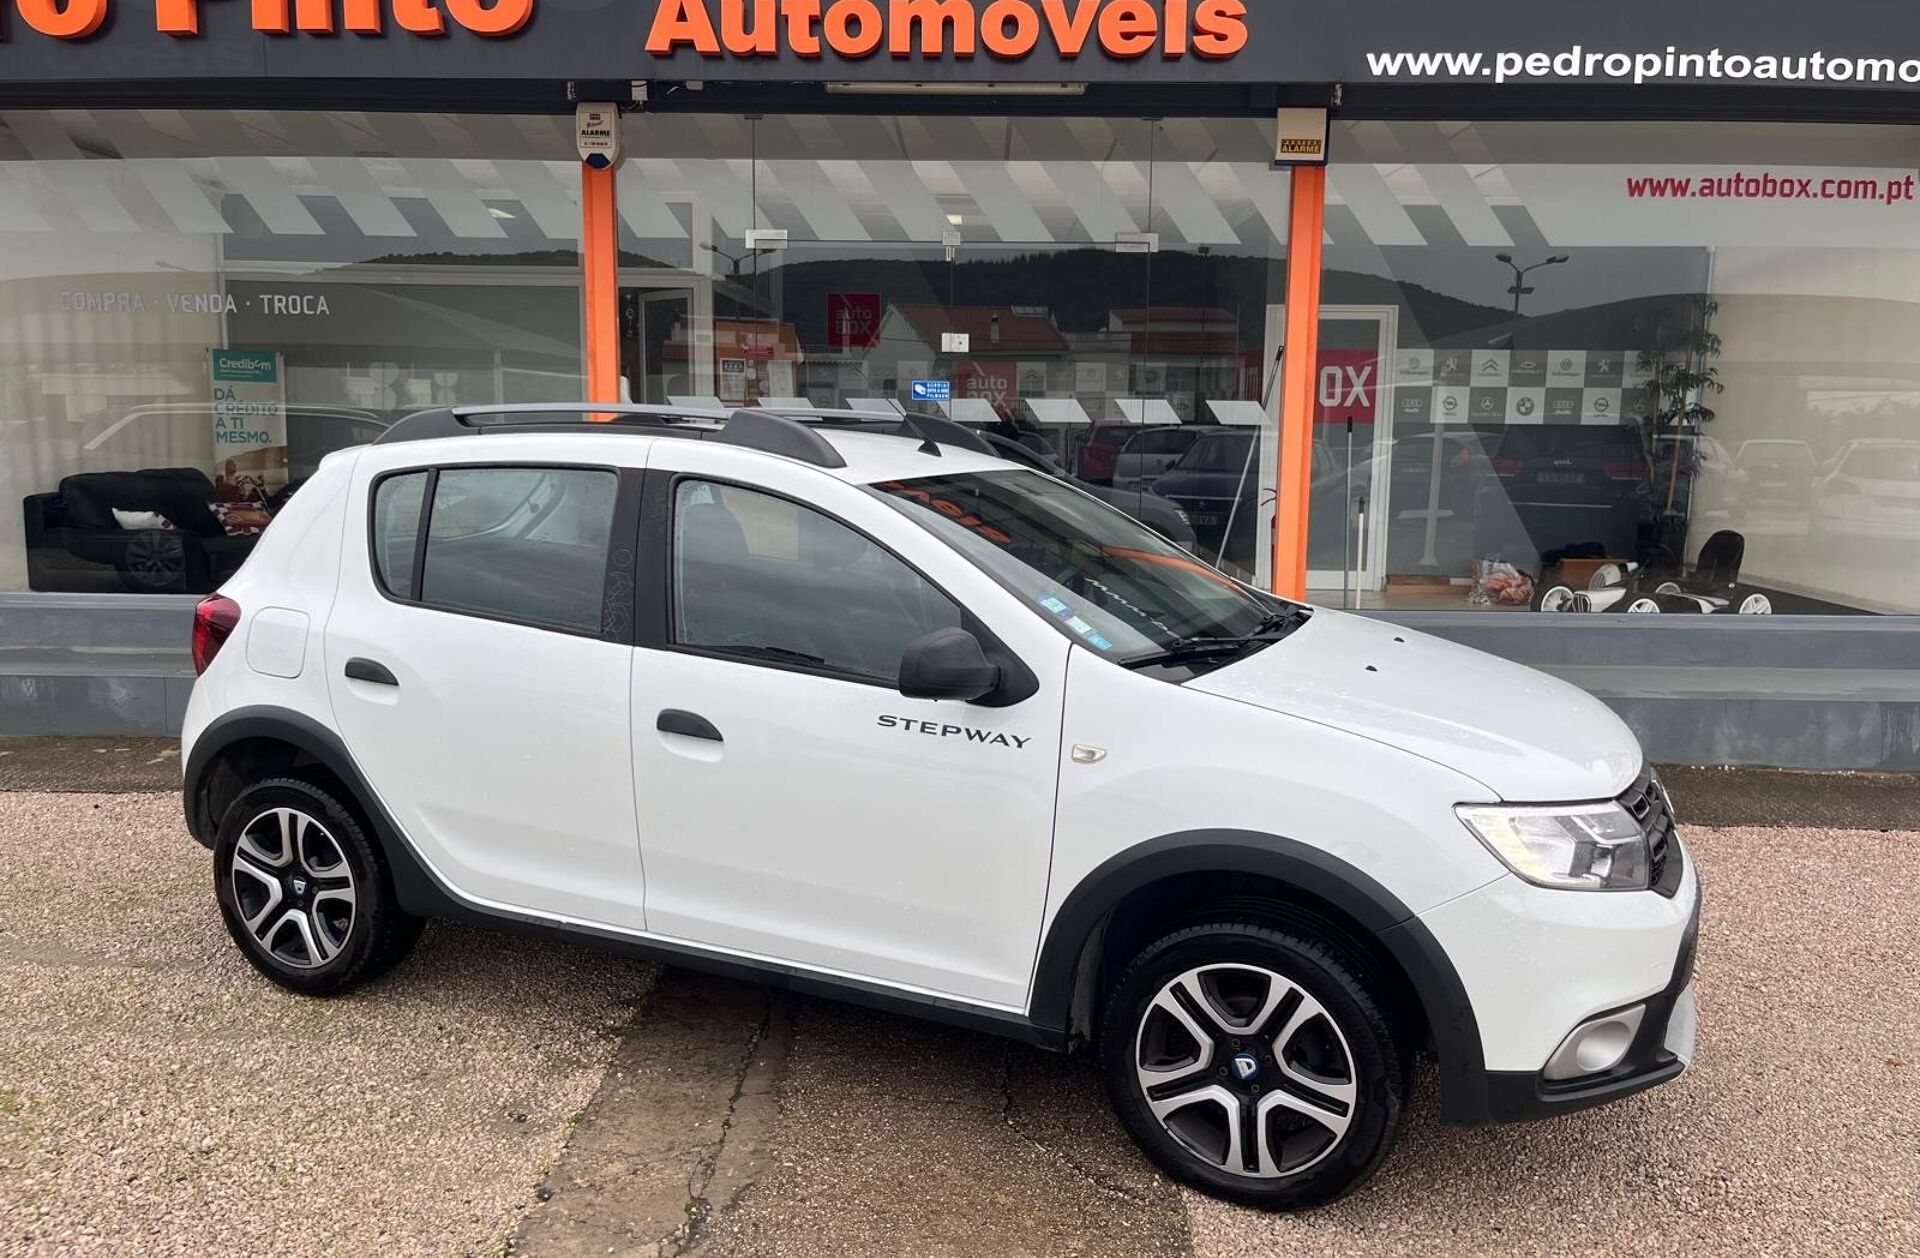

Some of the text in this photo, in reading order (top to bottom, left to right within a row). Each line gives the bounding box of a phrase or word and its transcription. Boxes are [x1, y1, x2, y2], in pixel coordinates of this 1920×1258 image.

[1366, 45, 1920, 84] www.pedropintoautomo
[1627, 172, 1914, 205] www.autobox.com.pt
[59, 291, 330, 315] COMPRA VENDA TROCA
[967, 376, 1008, 389] auto
[214, 385, 236, 400] DÁ
[215, 417, 244, 430] A TI
[216, 431, 272, 444] MESMO.
[877, 714, 1032, 749] STEPWAY
